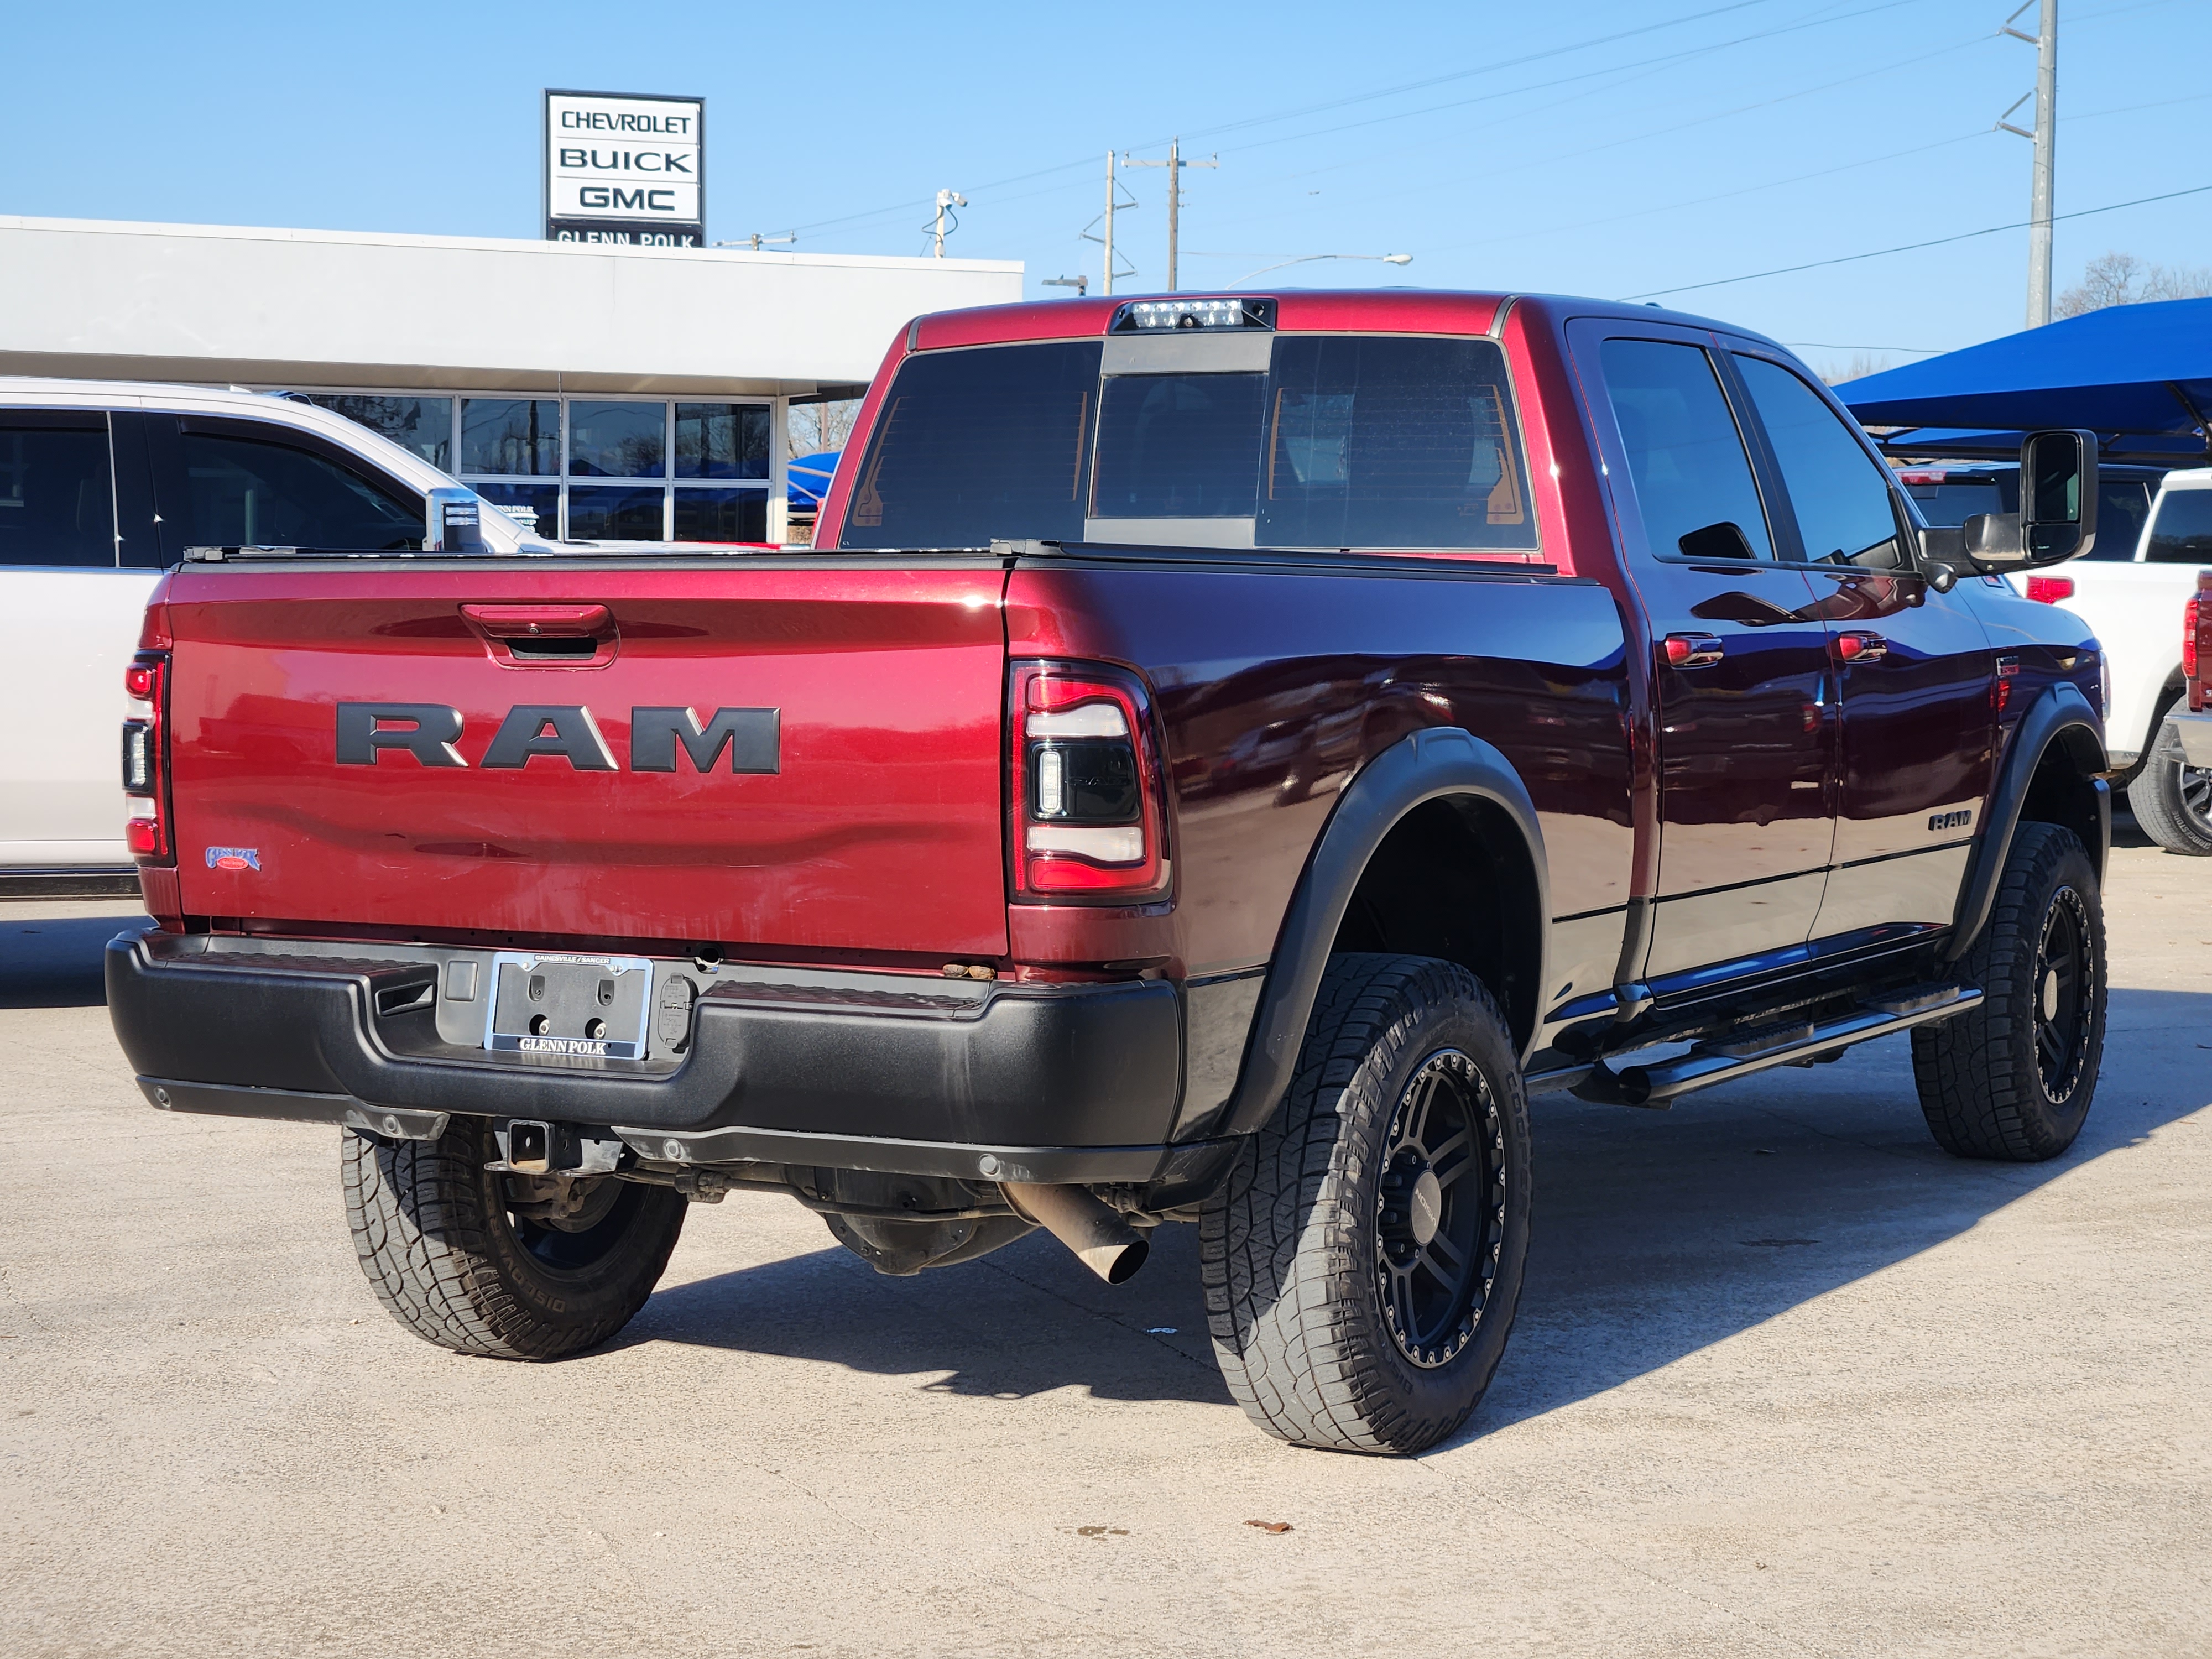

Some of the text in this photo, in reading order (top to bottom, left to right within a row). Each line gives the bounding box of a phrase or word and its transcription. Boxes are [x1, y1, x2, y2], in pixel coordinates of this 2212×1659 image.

[561, 111, 691, 134] CHEVROLET
[560, 148, 693, 173] BUICK
[579, 186, 675, 212] GMC
[336, 701, 781, 774] RAM
[1928, 810, 1973, 831] RAM
[2171, 810, 2211, 849] BRIDGESTONE
[519, 1037, 607, 1055] GLENN POLK
[1415, 1187, 1437, 1227] VISION
